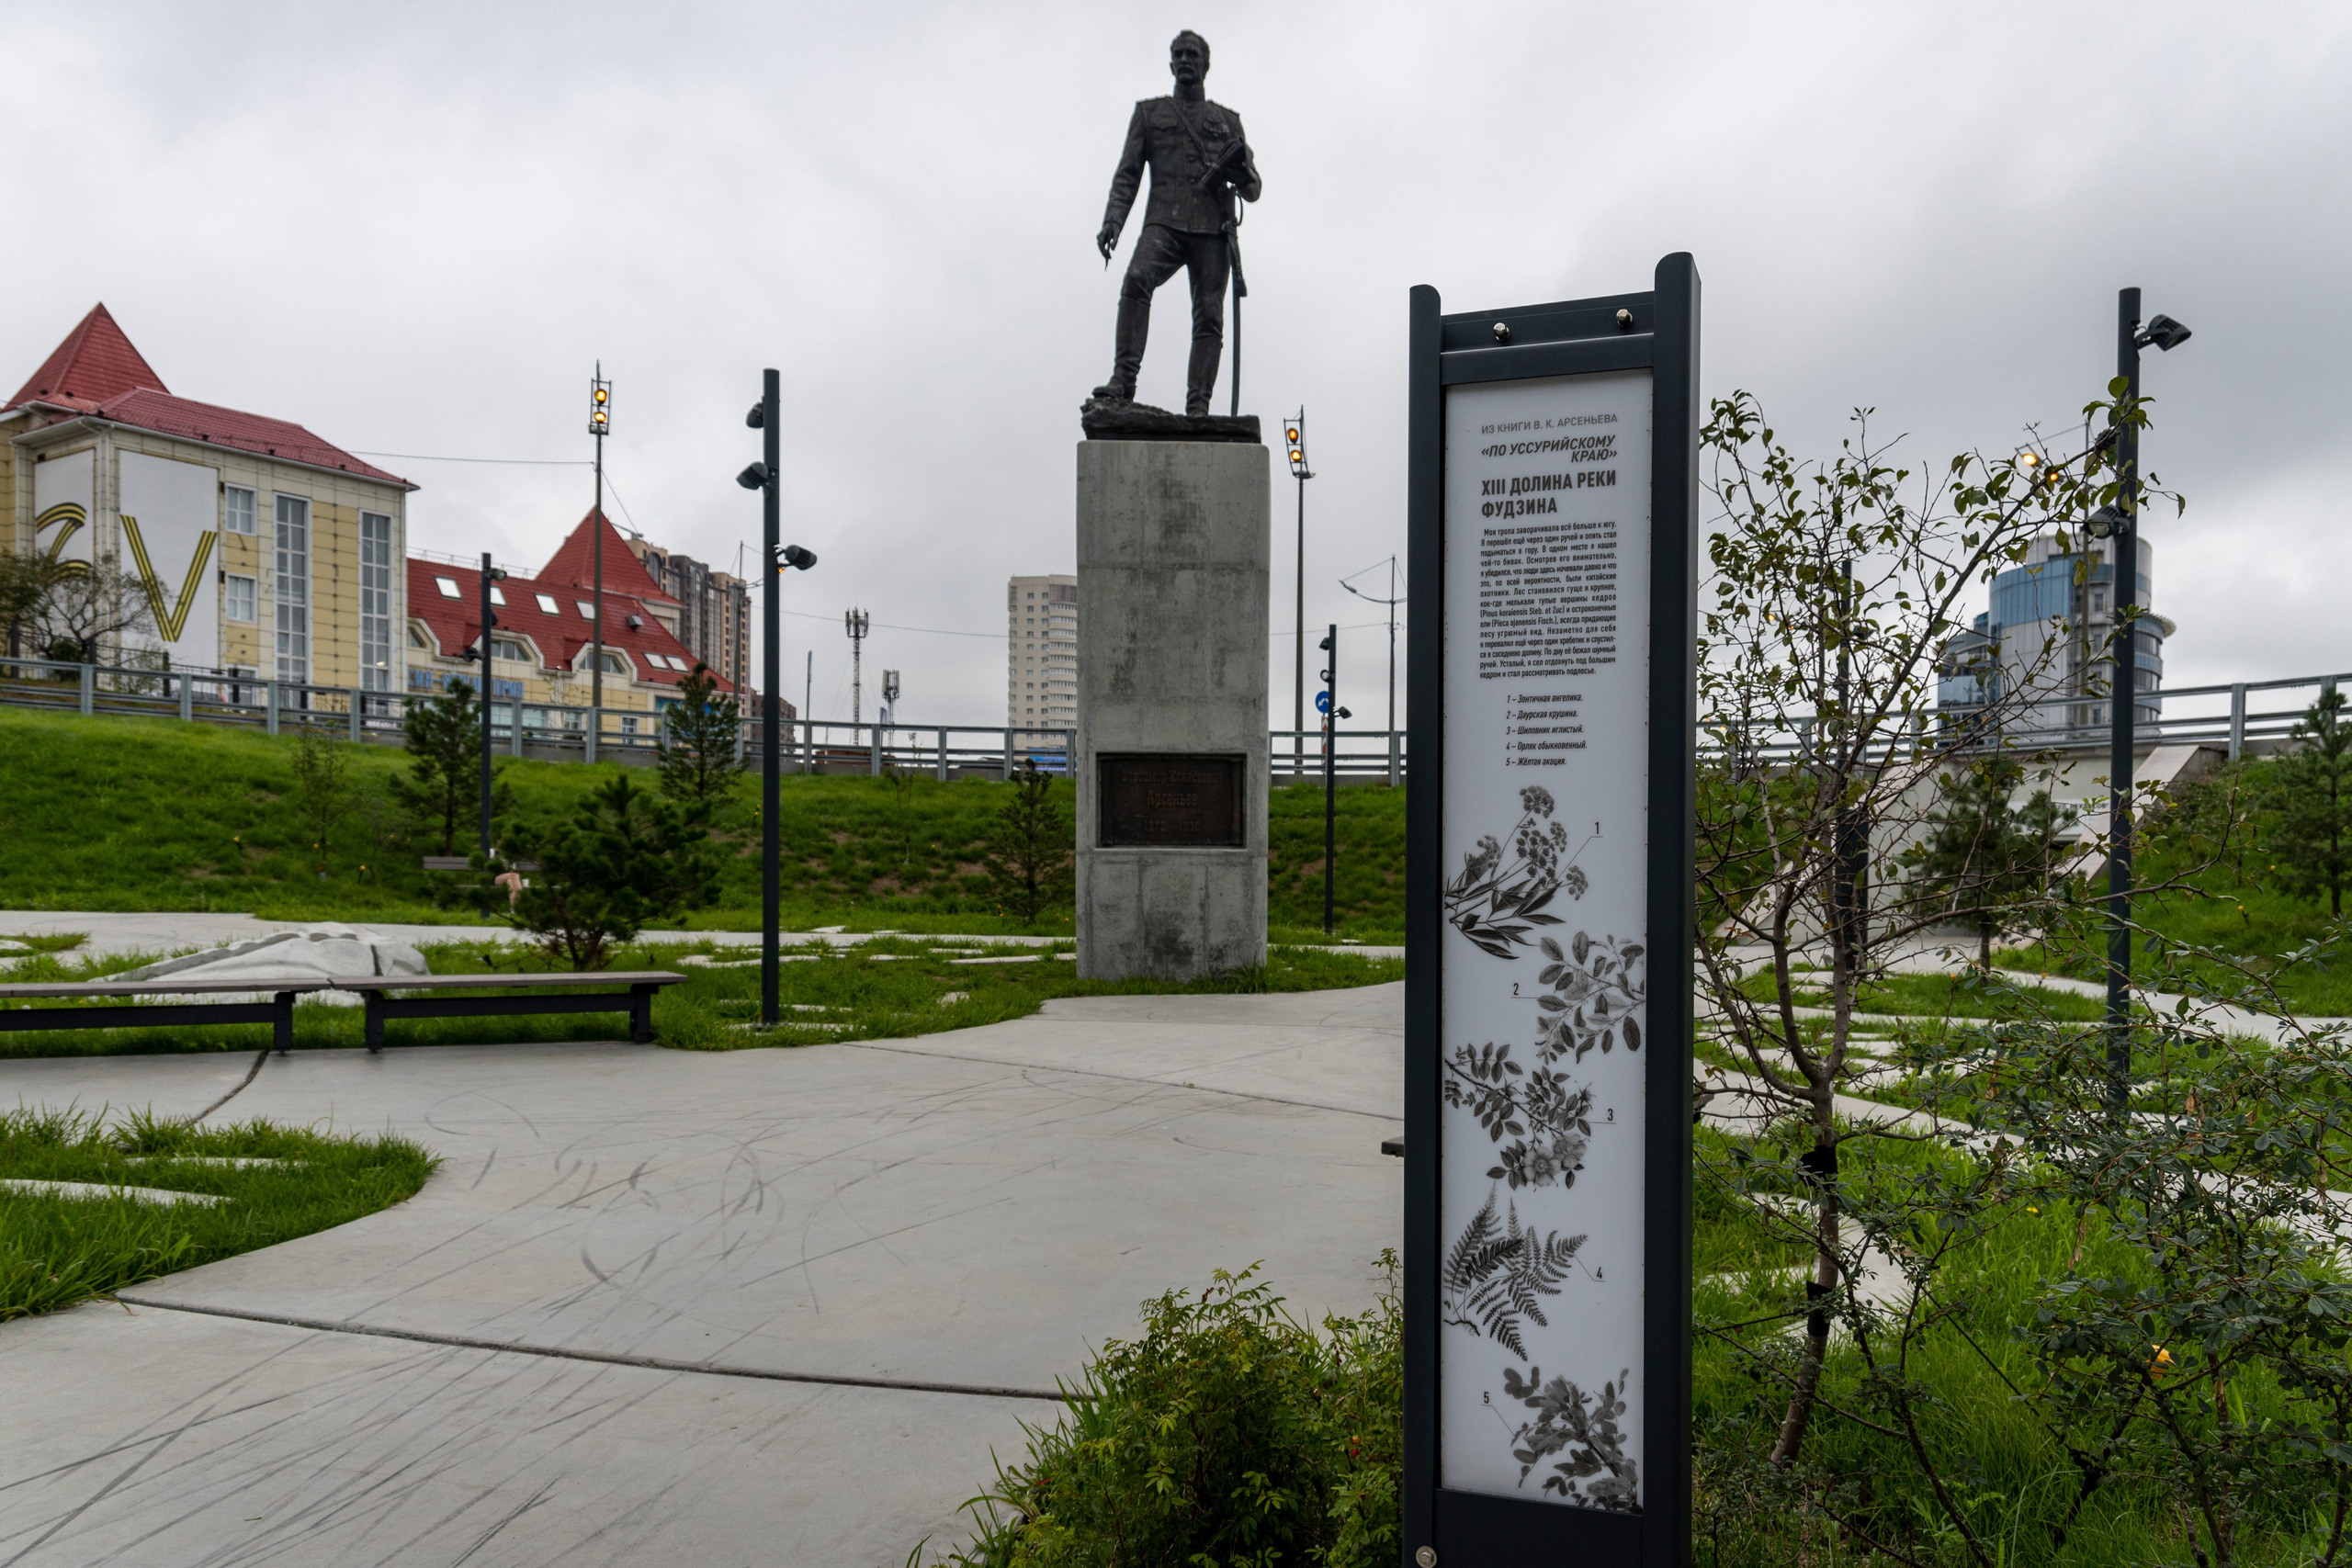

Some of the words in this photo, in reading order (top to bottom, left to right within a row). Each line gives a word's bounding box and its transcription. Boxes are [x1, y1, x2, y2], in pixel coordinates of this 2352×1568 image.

[1481, 425, 1494, 434] ИЗ
[1498, 422, 1531, 432] КНИГИ
[1534, 420, 1543, 429] В.
[1546, 419, 1554, 428] К.
[1557, 414, 1617, 427] АРСЕНЬЕВА
[1481, 445, 1506, 457] «ПО
[1510, 435, 1616, 455] УССУРИЙСКОМУ
[1571, 448, 1617, 463] КРАЮ»
[1510, 474, 1572, 496] ДОЛИНА
[1577, 470, 1616, 488] РЕКИ
[1481, 497, 1557, 519] ФУДЗИНА
[1484, 528, 1496, 536] Моя
[1497, 528, 1514, 537] тропа
[1516, 526, 1559, 536] заворачивала
[1560, 523, 1571, 531] всё
[1572, 521, 1596, 531] больше
[1603, 522, 1616, 530] югу.
[1486, 537, 1511, 548] перешёл
[1513, 536, 1525, 546] ещё
[1526, 537, 1543, 545] через
[1544, 536, 1559, 544] один
[1560, 533, 1577, 543] ручей
[1480, 549, 1515, 558] подыматься
[1525, 547, 1539, 555] гору.
[1549, 546, 1567, 554] одном
[1503, 557, 1523, 566] бивак.
[1526, 555, 1556, 566] Осмотрев
[1523, 568, 1538, 576] люди
[1539, 567, 1555, 575] здесь
[1583, 564, 1601, 573] давно
[1506, 577, 1520, 586] всей
[1565, 574, 1581, 583] были
[1586, 572, 1616, 582] китайские
[1513, 587, 1525, 595] Лес
[1480, 600, 1502, 609] кое-где
[1560, 596, 1587, 605] вершины
[1592, 595, 1616, 603] кедров
[1571, 605, 1616, 615] остроконечные
[1560, 617, 1580, 625] всегда
[1581, 616, 1616, 625] придающие
[1497, 628, 1527, 638] угрюмый
[1547, 626, 1582, 635] Незаметно
[1600, 624, 1616, 633] себя
[1484, 640, 1513, 649] перевалил
[1514, 638, 1526, 648] ещё
[1559, 636, 1585, 646] хребетик
[1492, 650, 1520, 659] соседнюю
[1572, 646, 1591, 654] бежал
[1592, 645, 1615, 655] шумный
[1480, 659, 1498, 669] ручей.
[1544, 659, 1574, 667] отдохнуть
[1588, 656, 1615, 664] большим
[1521, 669, 1565, 678] рассматривать
[1566, 669, 1596, 677] подлесье.
[1518, 694, 1551, 703] Зонтичная
[1517, 710, 1548, 721] Даурская
[1549, 711, 1578, 719] крушина.
[1506, 727, 1511, 735] 3
[1517, 725, 1551, 734] Шиповник
[1552, 724, 1583, 733] иглистый.
[1517, 742, 1537, 752] Орляк
[1538, 741, 1587, 750] обыкновенный.
[1517, 757, 1542, 766] Жёлтая
[1542, 758, 1566, 767] акация.
[1122, 770, 1167, 784] Владимир
[1170, 770, 1223, 783] Клавдиевич
[1147, 790, 1199, 809] Арсеньев
[1595, 822, 1599, 834] 1
[1513, 983, 1519, 995] 2
[1608, 1108, 1613, 1121] 3
[1597, 1266, 1602, 1279] 4
[1484, 1391, 1489, 1404] 5
